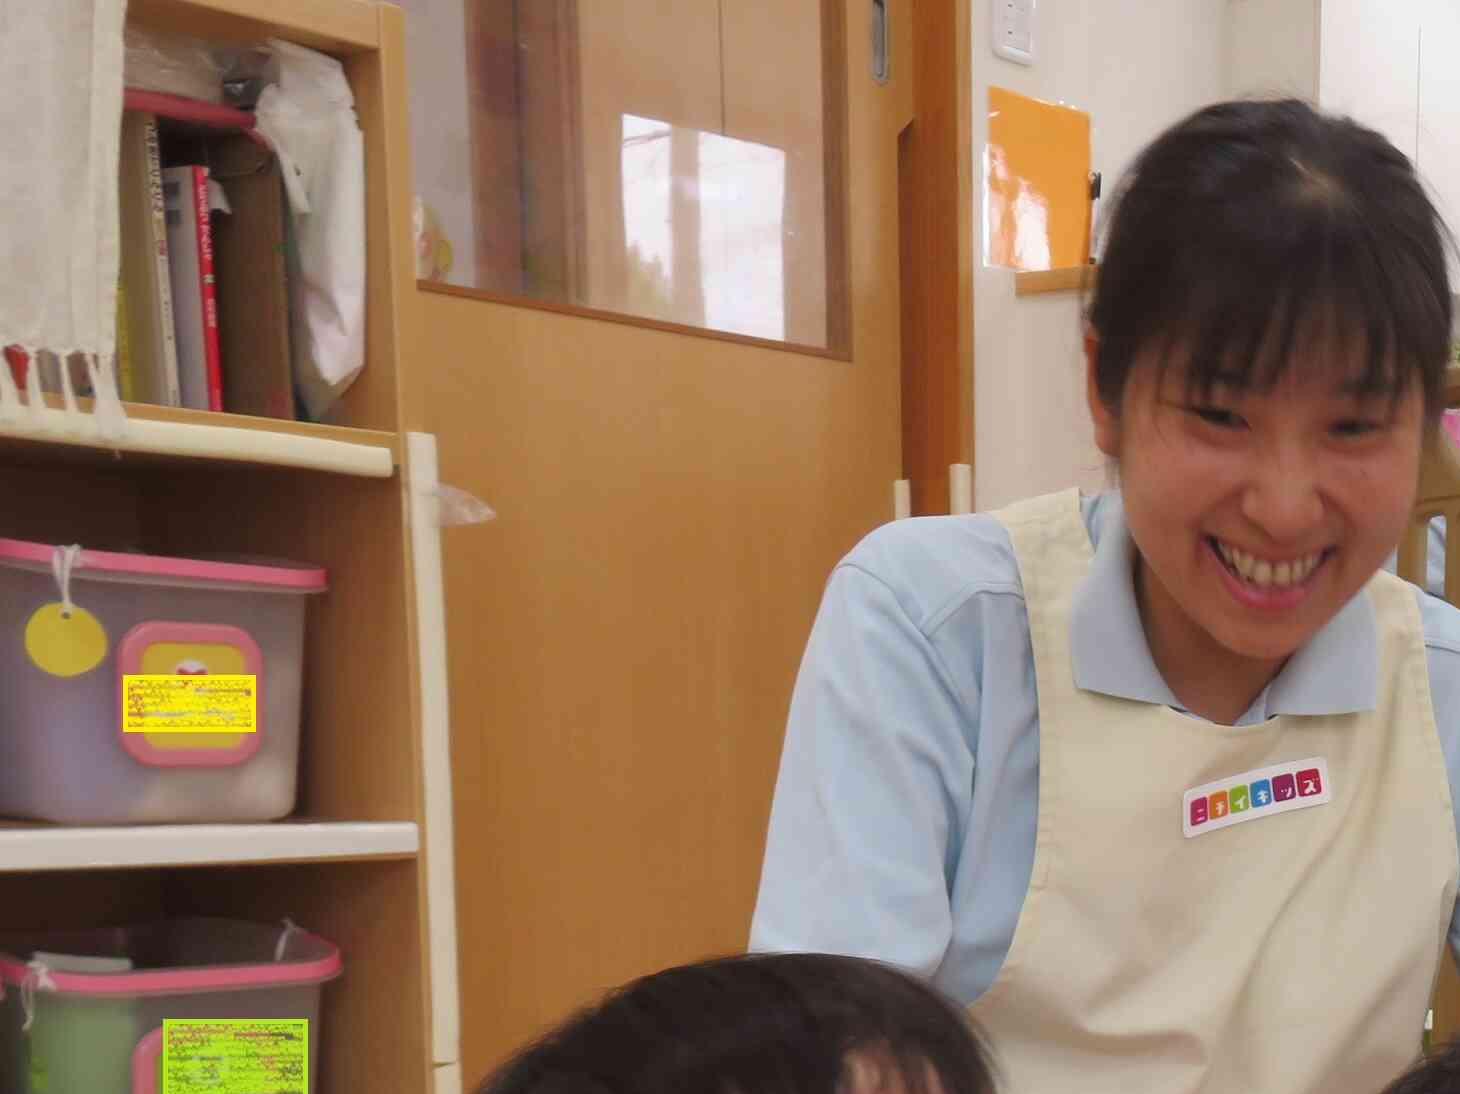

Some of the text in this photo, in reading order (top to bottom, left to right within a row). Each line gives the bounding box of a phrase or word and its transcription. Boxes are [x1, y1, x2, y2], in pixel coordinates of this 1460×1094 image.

[1192, 772, 1321, 824] ニチイキッズ
